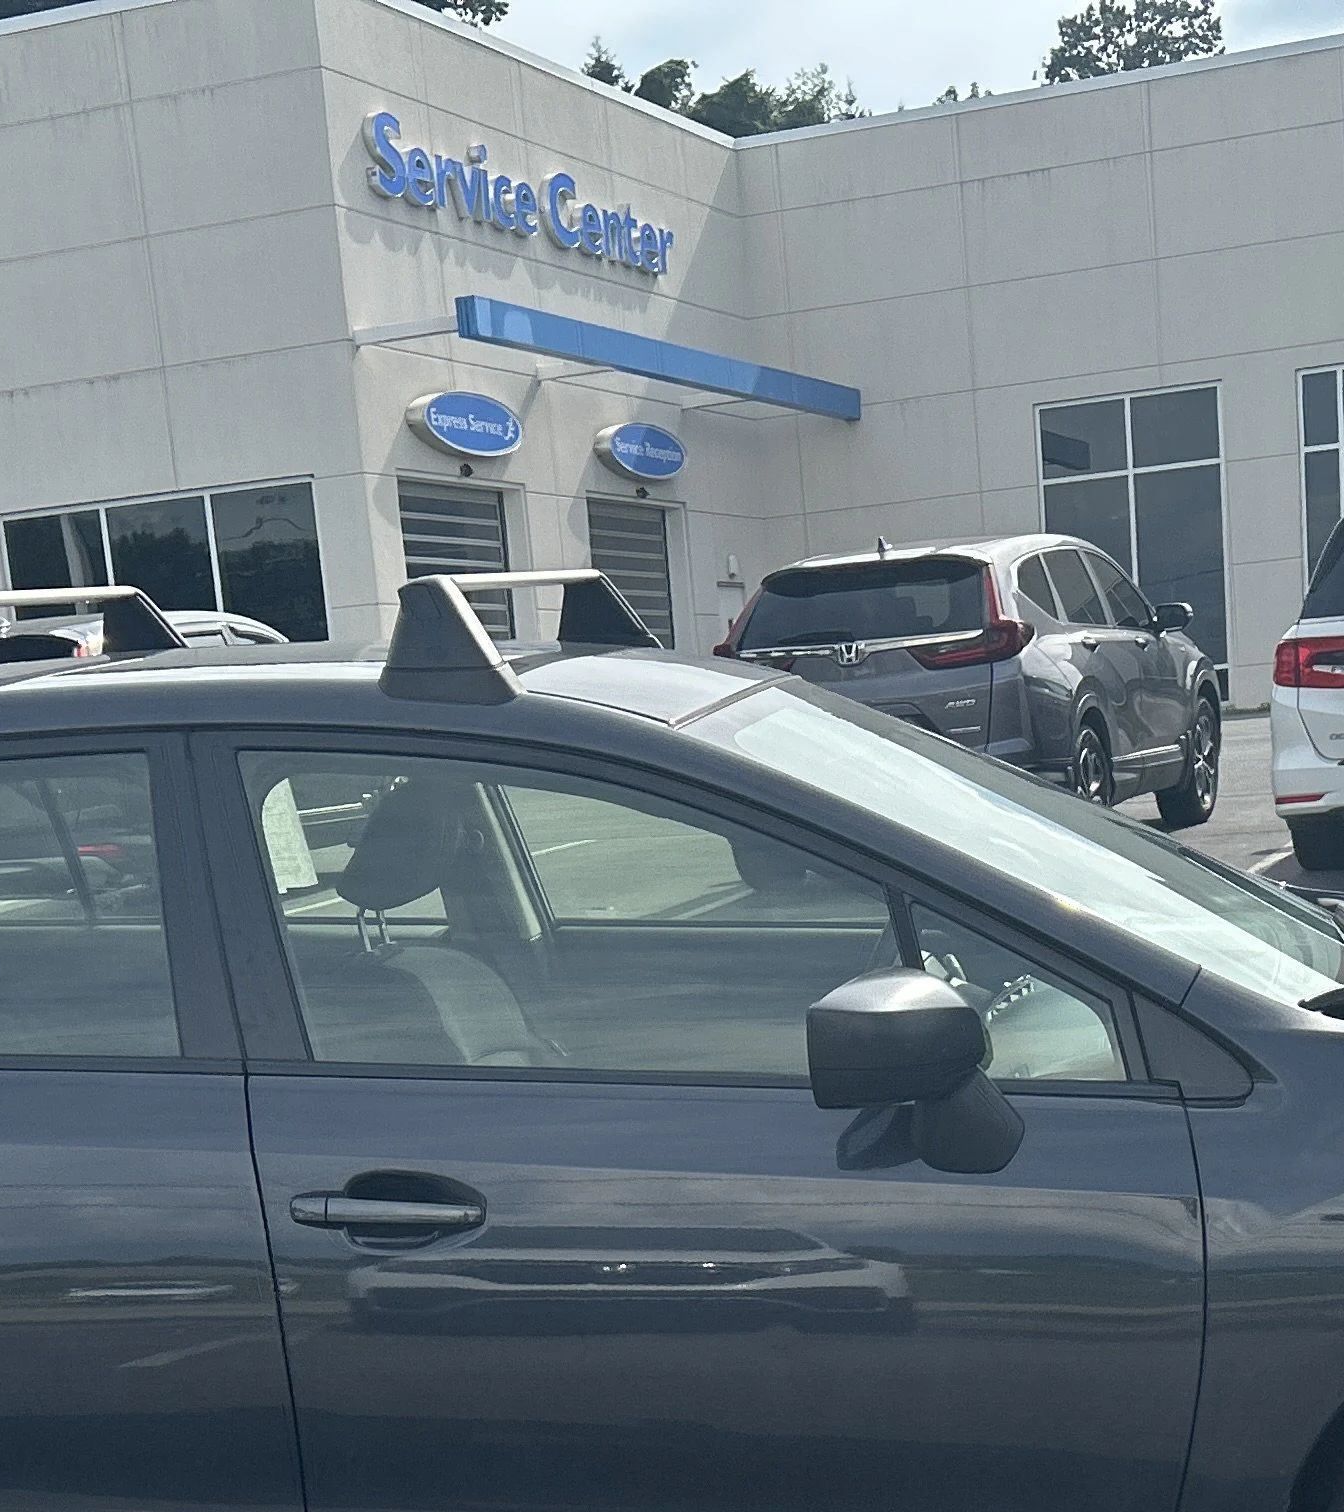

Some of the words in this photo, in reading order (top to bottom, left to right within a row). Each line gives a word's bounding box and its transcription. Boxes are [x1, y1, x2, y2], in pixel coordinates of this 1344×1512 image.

[362, 111, 537, 237] Service
[541, 172, 674, 276] Center
[430, 407, 467, 432] Express
[468, 414, 503, 436] Service
[614, 437, 644, 456] Service
